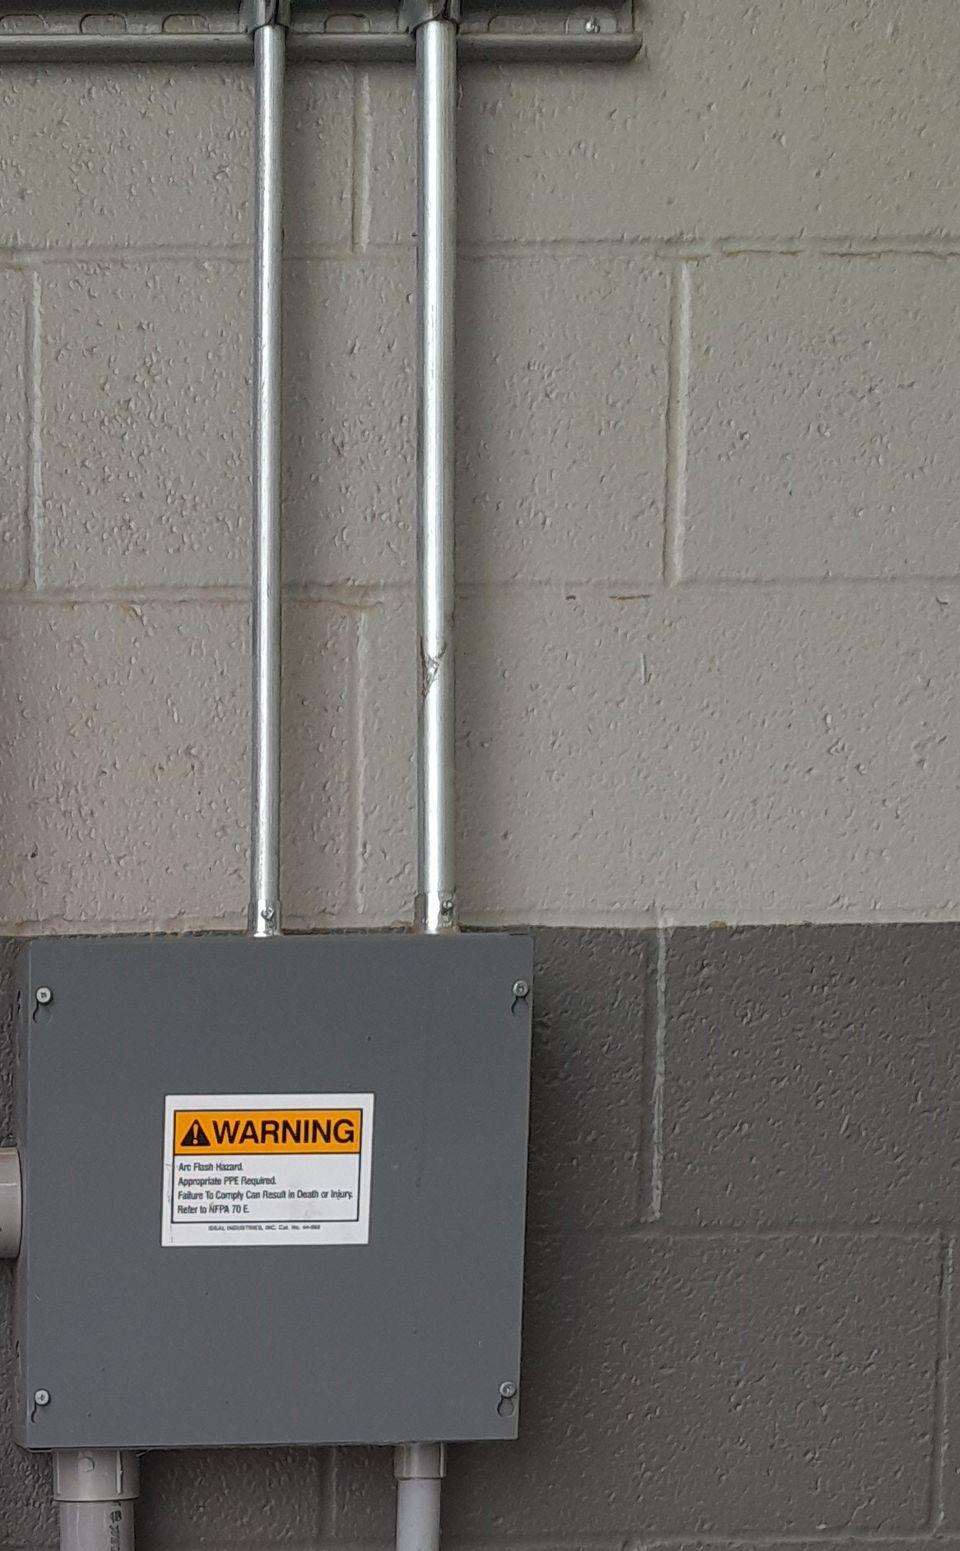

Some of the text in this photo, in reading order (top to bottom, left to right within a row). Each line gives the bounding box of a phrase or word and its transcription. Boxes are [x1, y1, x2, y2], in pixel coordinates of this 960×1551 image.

[212, 1118, 354, 1144] WARNING
[178, 1162, 244, 1172] Arc Flash Hazard.
[178, 1176, 276, 1188] Appropriate PPE Required.
[178, 1190, 204, 1200] Failure
[206, 1190, 214, 1200] To
[215, 1190, 244, 1202] Comply
[246, 1190, 260, 1200] Can
[262, 1190, 286, 1200] Result
[288, 1190, 296, 1200] in
[296, 1190, 320, 1199] Death
[330, 1190, 354, 1200] Injury.
[177, 1204, 250, 1214] Refer to NFPA 70 E.
